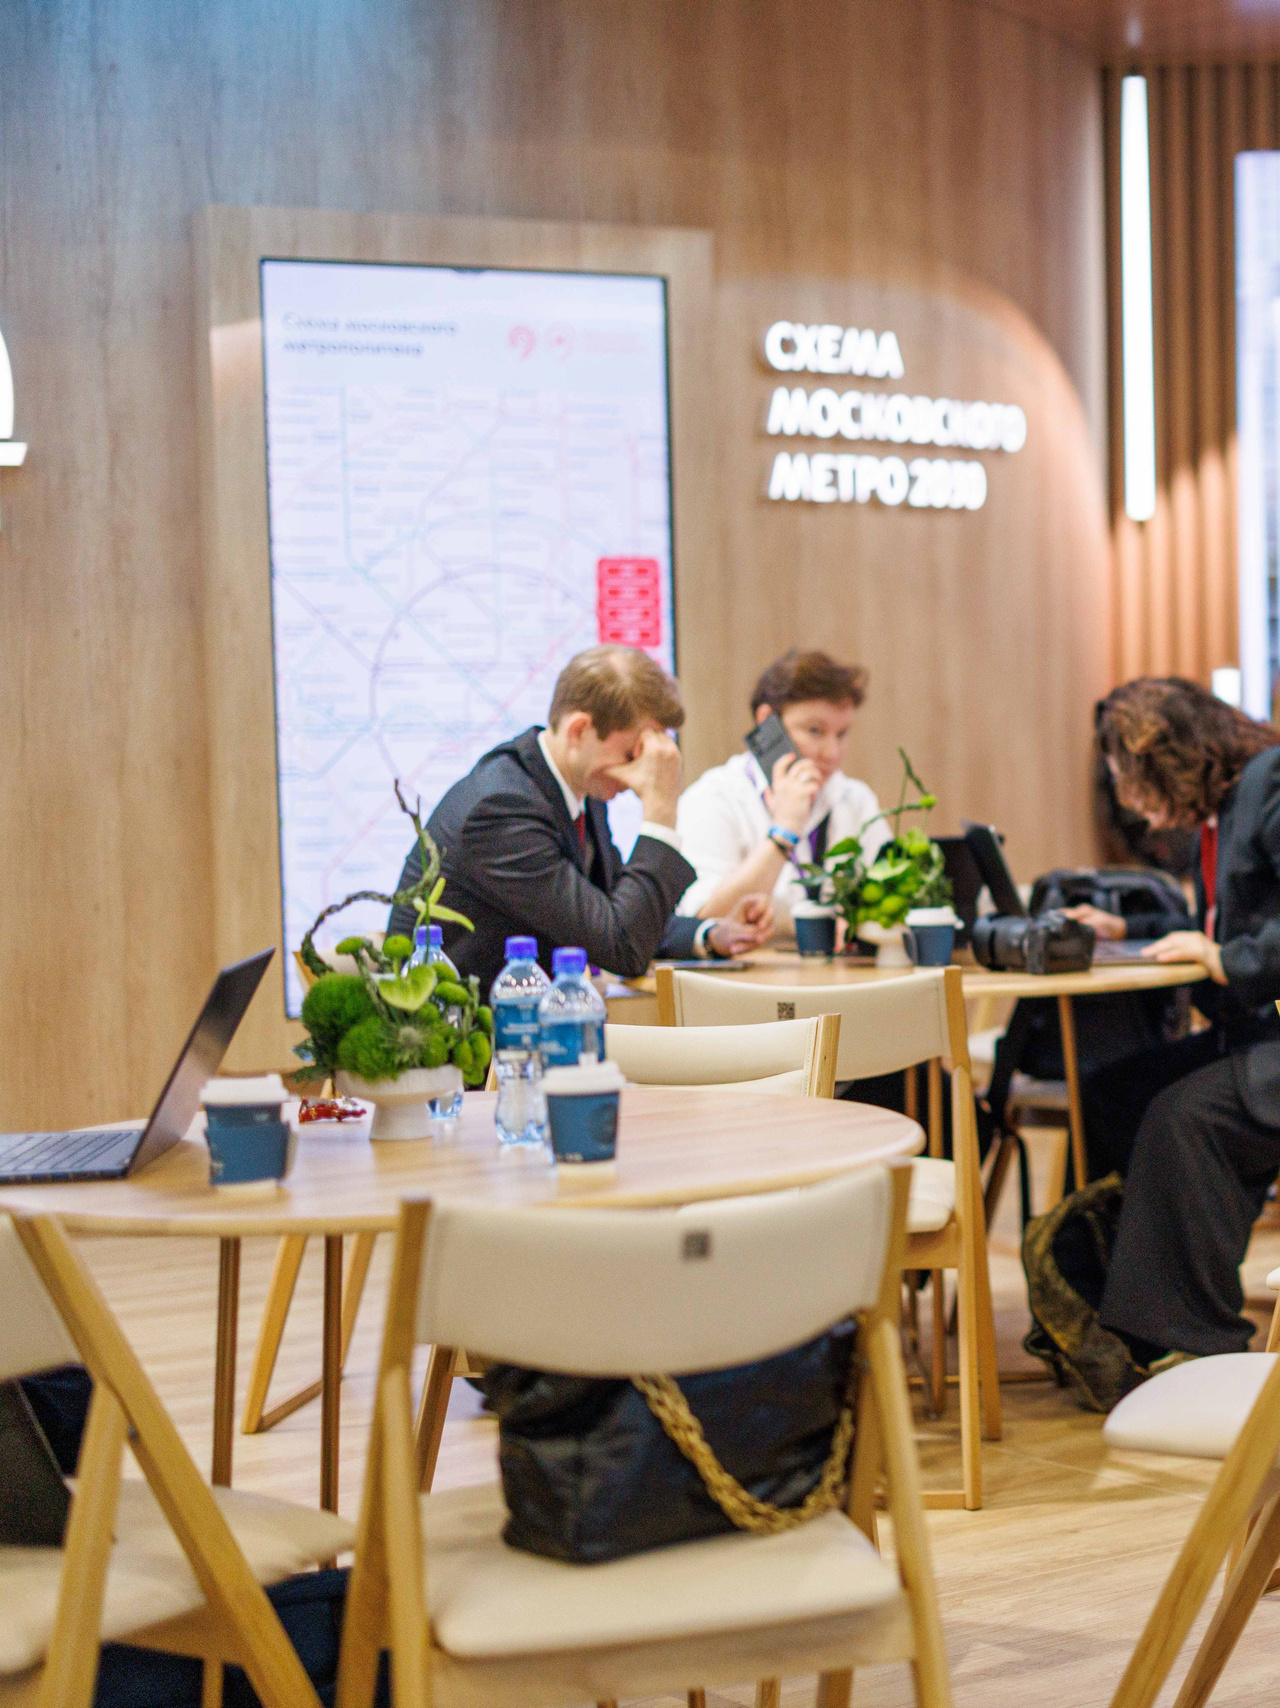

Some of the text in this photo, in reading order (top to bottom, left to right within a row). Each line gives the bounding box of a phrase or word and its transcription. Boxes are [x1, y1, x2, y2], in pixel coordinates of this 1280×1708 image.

[765, 320, 905, 380] СХЕМА
[766, 386, 1027, 453] МОСКОВСКОГО
[768, 451, 910, 507] МЕТРО
